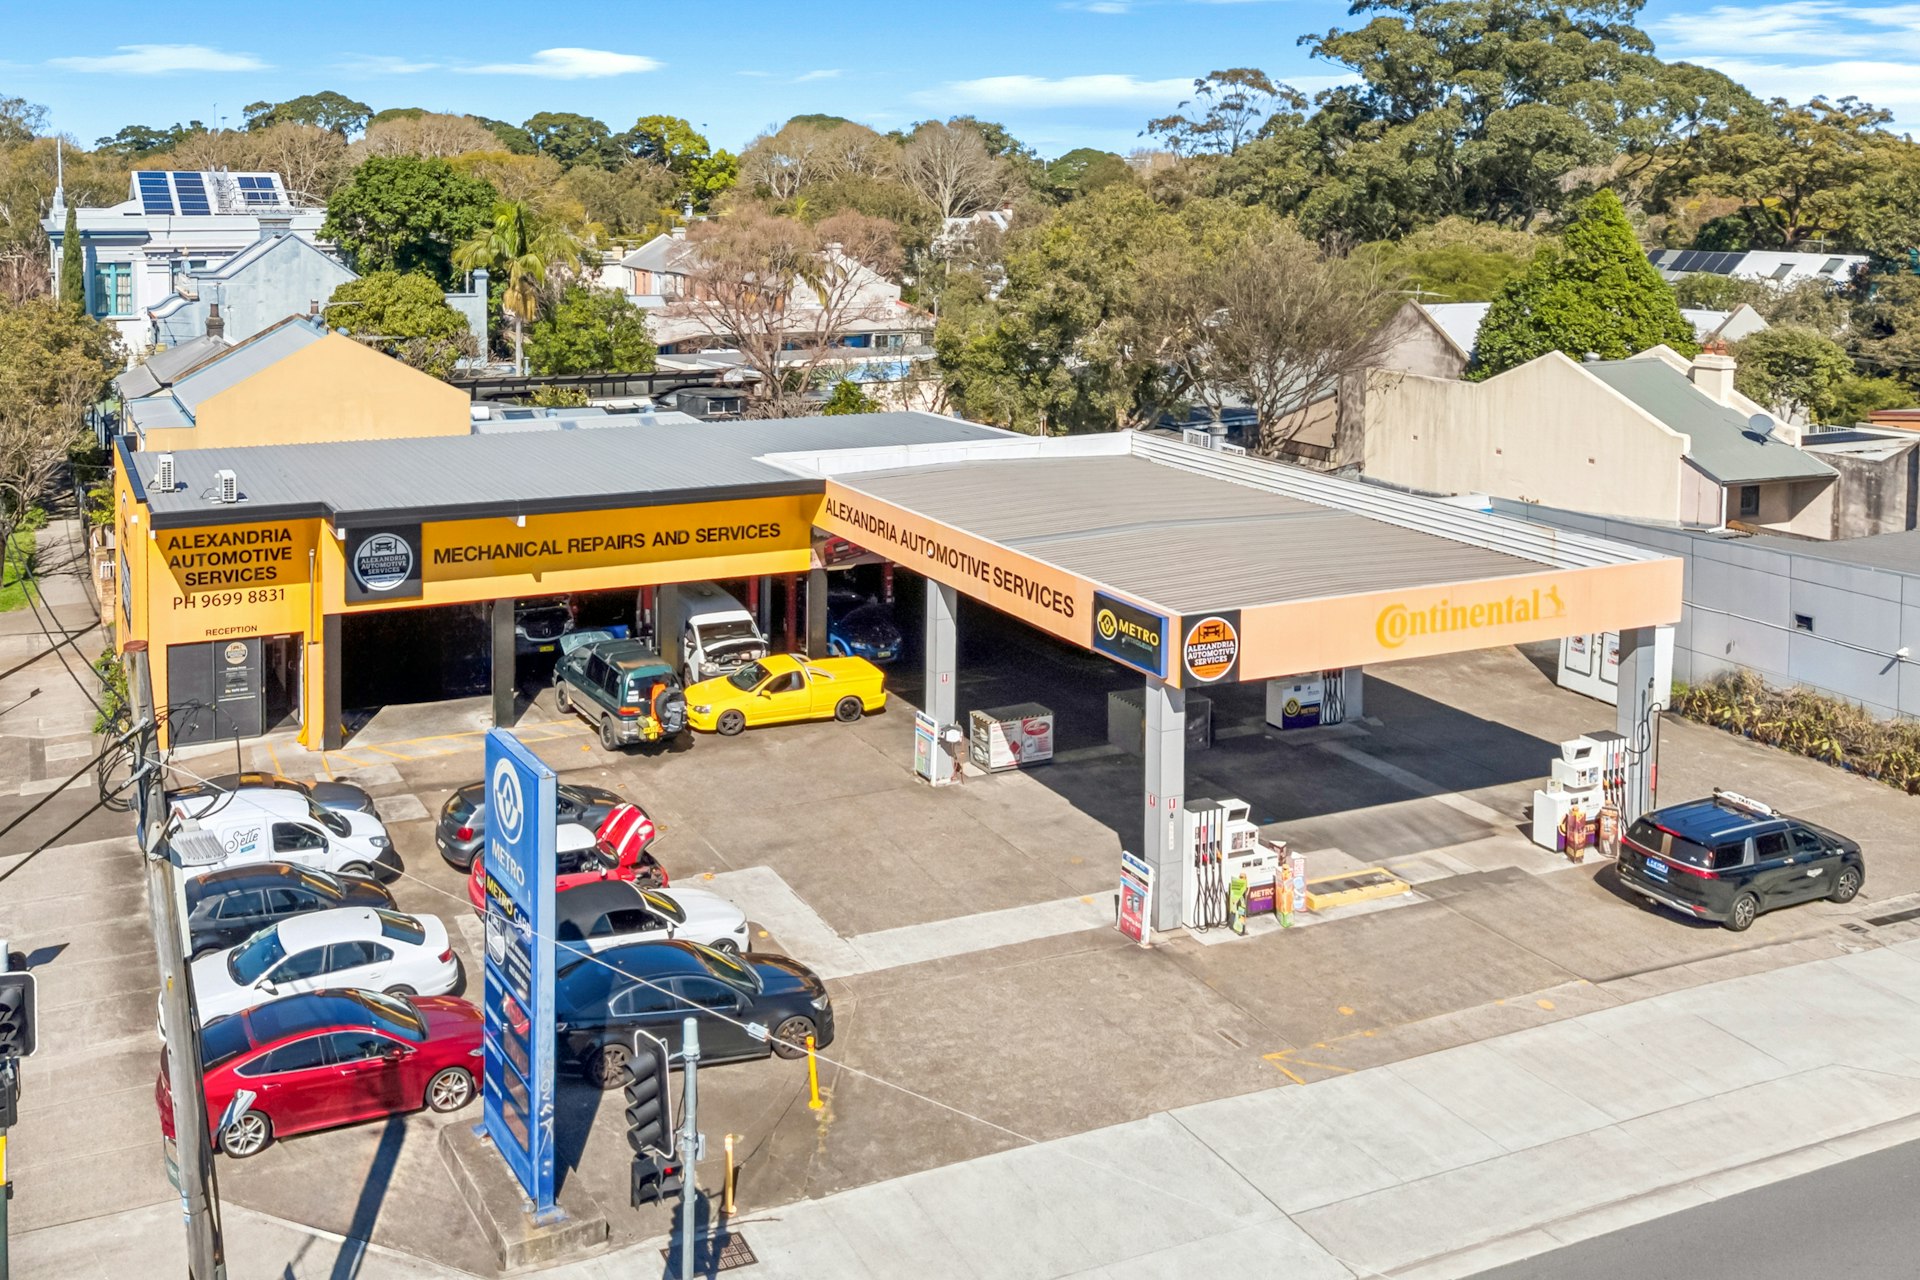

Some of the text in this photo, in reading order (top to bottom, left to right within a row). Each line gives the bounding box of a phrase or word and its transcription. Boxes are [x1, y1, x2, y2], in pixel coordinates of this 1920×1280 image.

[168, 528, 292, 550] ALEXANDRIA
[433, 523, 781, 564] MECHANICAL REPAIRS AND SERVICES
[168, 547, 292, 569] AUTOMOTIVE
[361, 555, 407, 564] ALEXANDRIA
[361, 561, 407, 570] AUTOMOTIVE
[825, 498, 1074, 618] ALEXANDRIA AUTOMOTIVE SERVICES
[185, 566, 277, 586] SERVICES
[367, 566, 400, 575] SERVICES
[173, 588, 285, 610] PH 9699 8831
[1375, 588, 1540, 648] Continental
[205, 625, 258, 636] RECEPTION
[1119, 619, 1159, 646] METRO
[1188, 641, 1234, 652] ALEXANDRIA
[1188, 648, 1235, 660] AUTOMOTIVE
[1194, 656, 1227, 666] SERVICES
[492, 838, 525, 887] METRO
[486, 876, 513, 916] METRO
